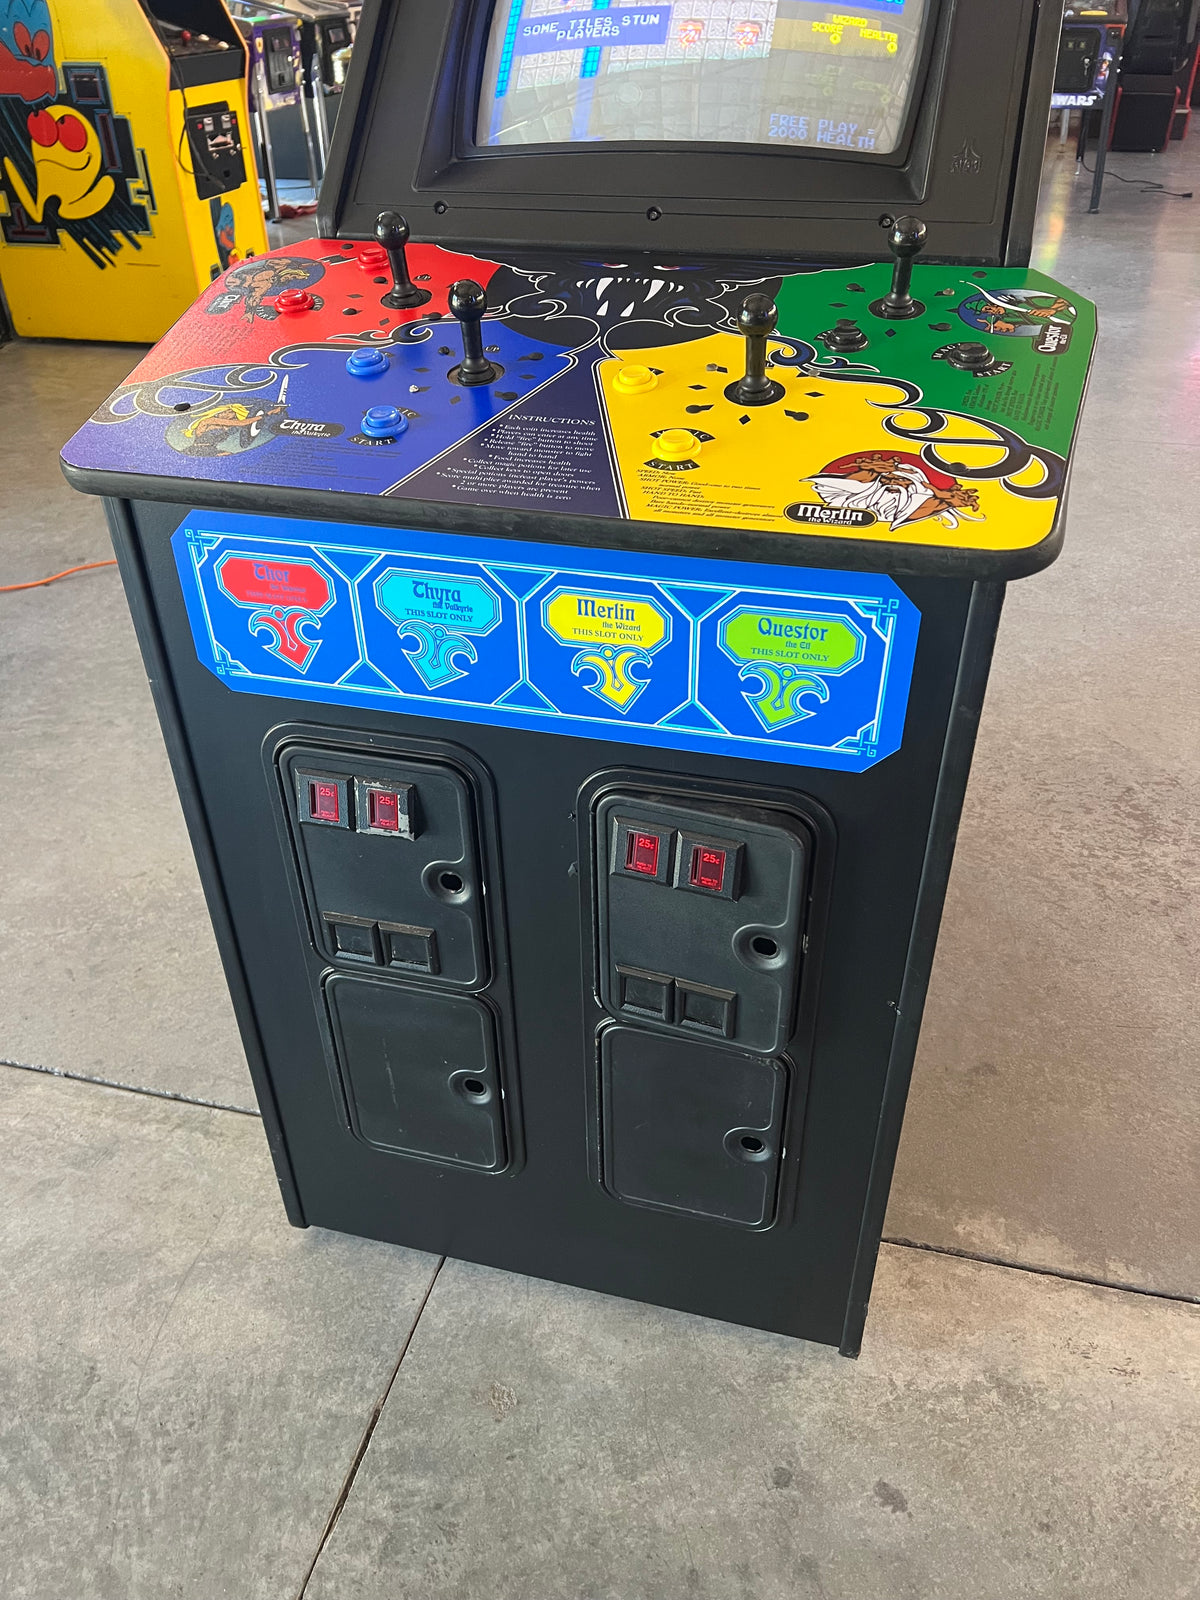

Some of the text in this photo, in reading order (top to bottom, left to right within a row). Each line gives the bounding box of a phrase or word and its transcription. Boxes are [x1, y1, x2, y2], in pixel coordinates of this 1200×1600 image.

[523, 14, 660, 37] SOME TILES STUN
[556, 25, 620, 41] PLAYERS
[811, 21, 898, 42] SCORE HEALTH
[769, 113, 808, 129] FREE
[818, 119, 858, 134] PLAY
[768, 125, 875, 149] 2000 HEALTH
[976, 362, 1011, 377] START
[280, 419, 326, 434] Thyra
[509, 415, 596, 425] INSTRUCTIONS
[350, 437, 393, 446] START
[649, 461, 693, 471] START
[797, 504, 863, 521] Merlin
[253, 562, 290, 583] Thor
[412, 580, 462, 609] Thyra
[405, 608, 474, 622] THIS SLOT ONLY
[445, 602, 473, 613] Valkyrie
[577, 598, 636, 621] Merlin
[602, 621, 641, 632] the Wizard
[758, 617, 829, 641] Questor
[572, 627, 644, 642] THIS SLOT ONLY
[785, 640, 797, 649] the
[750, 647, 830, 662] THIS SLOT ONLY
